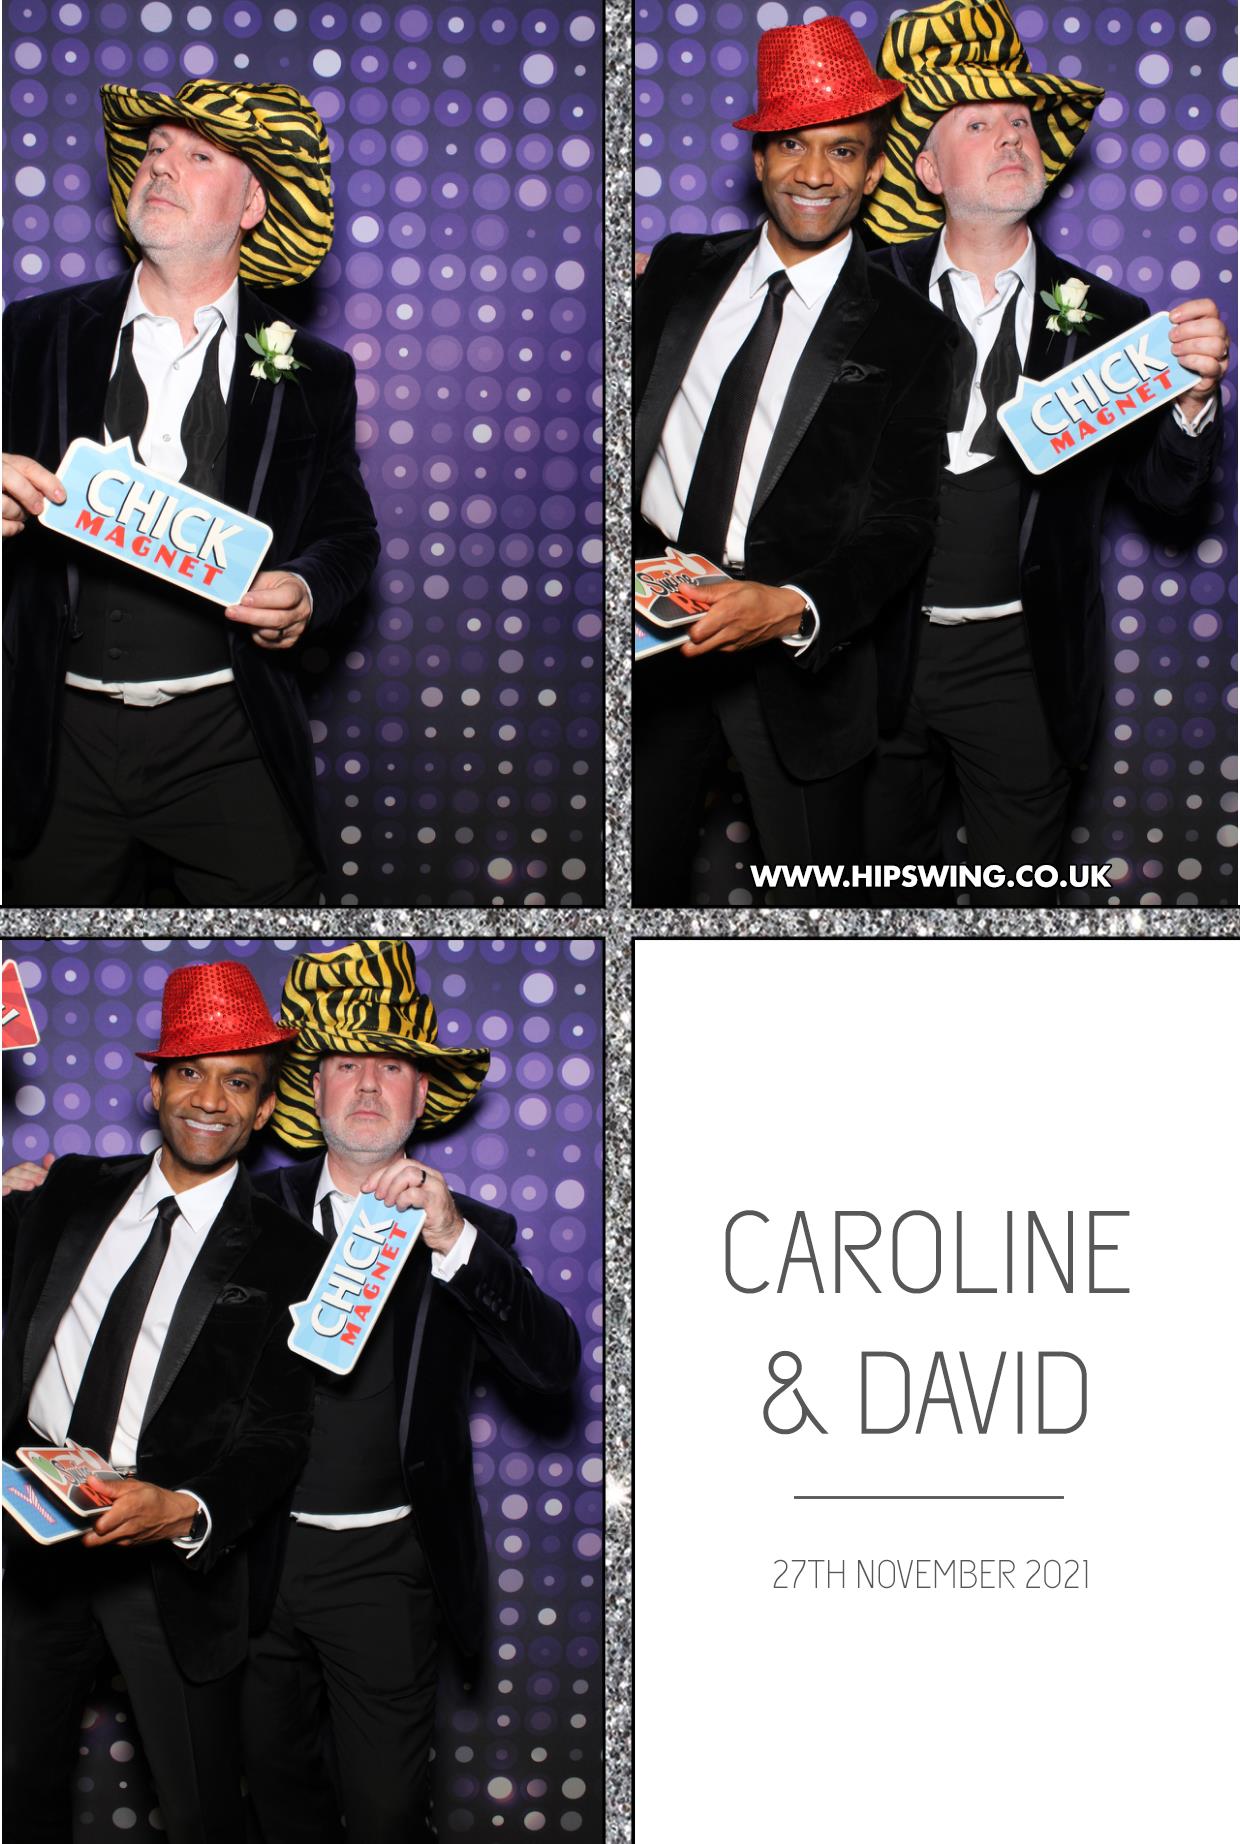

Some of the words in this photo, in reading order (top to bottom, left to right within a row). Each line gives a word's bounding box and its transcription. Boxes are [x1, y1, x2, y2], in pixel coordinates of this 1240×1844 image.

[1031, 334, 1169, 435] CHICK
[1050, 370, 1174, 454] MAGNET
[74, 508, 224, 587] MAGNET
[86, 468, 244, 570] CHICK
[311, 1208, 395, 1339] CHICK
[340, 1222, 408, 1346] MAGNET
